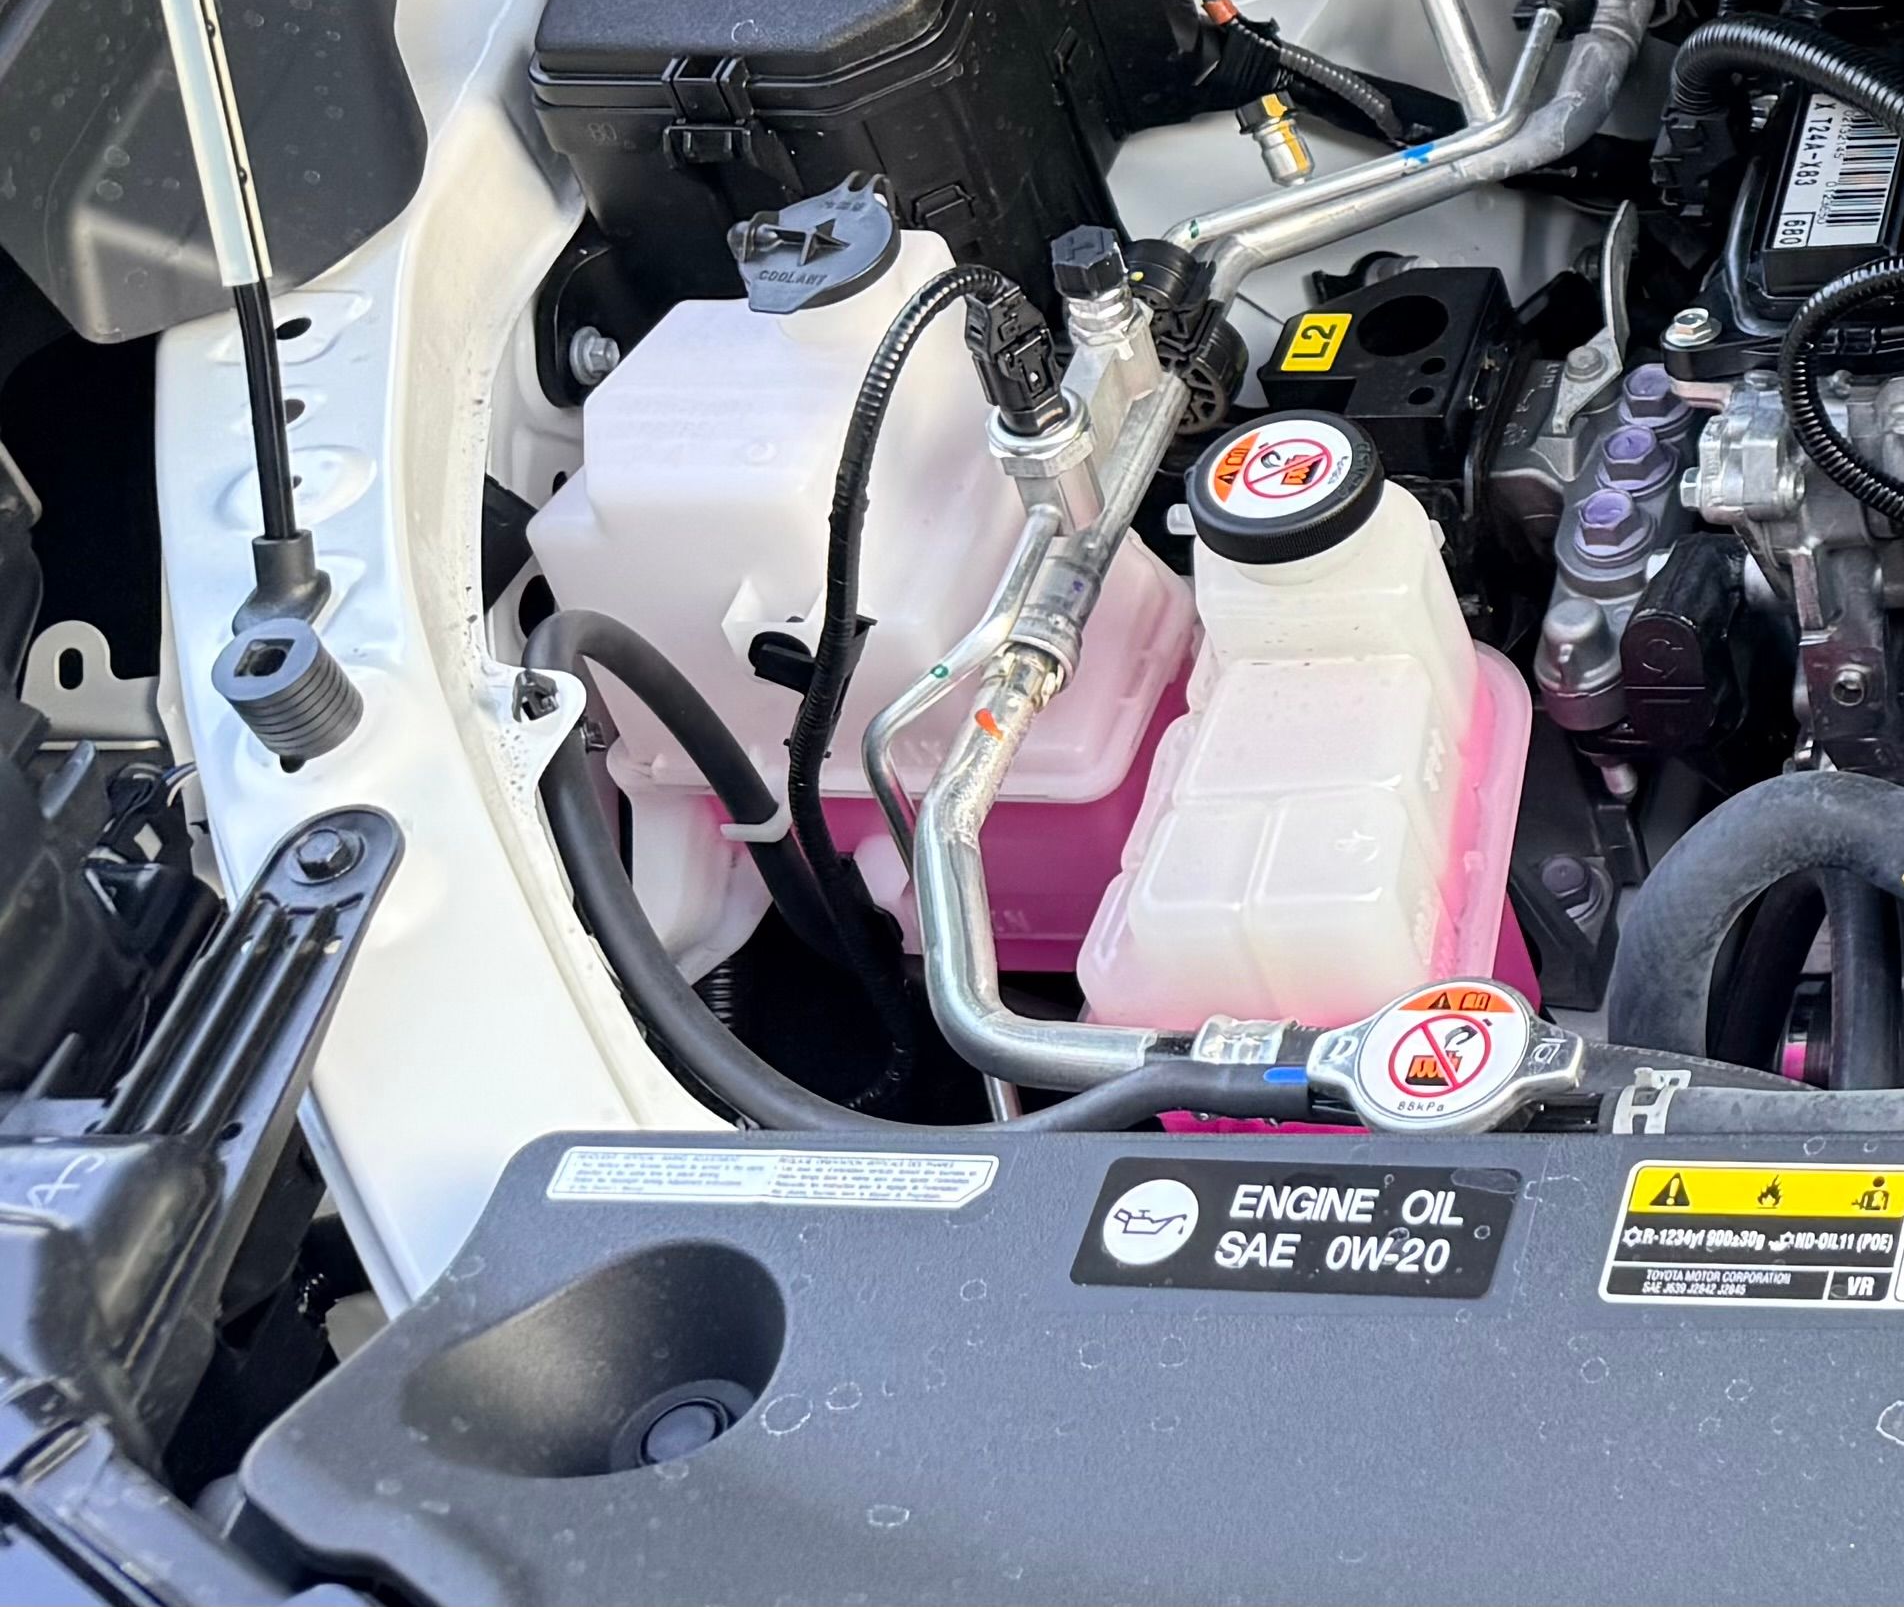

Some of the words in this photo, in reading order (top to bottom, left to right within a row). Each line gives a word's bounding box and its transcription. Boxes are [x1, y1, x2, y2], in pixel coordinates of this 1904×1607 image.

[1794, 116, 1834, 187] T24A-X83
[1779, 219, 1807, 245] 680
[757, 269, 829, 287] COOLANT
[1292, 323, 1338, 359] L2
[1396, 1099, 1446, 1113] 88kPa
[1229, 1183, 1380, 1223] ENGINE
[1401, 1189, 1464, 1226] OIL
[1214, 1231, 1302, 1269] SAE
[1325, 1235, 1451, 1274] 0W-20
[1641, 1227, 1706, 1250] R-1234yf
[1794, 1232, 1855, 1251] ND-OIL11
[1856, 1232, 1894, 1254] (POE)
[1641, 1282, 1662, 1294] SAE
[1646, 1269, 1684, 1282] TOYOTA
[1685, 1270, 1721, 1283] MOTOR
[1722, 1271, 1792, 1285] CORPORATION
[1847, 1276, 1875, 1296] VR
